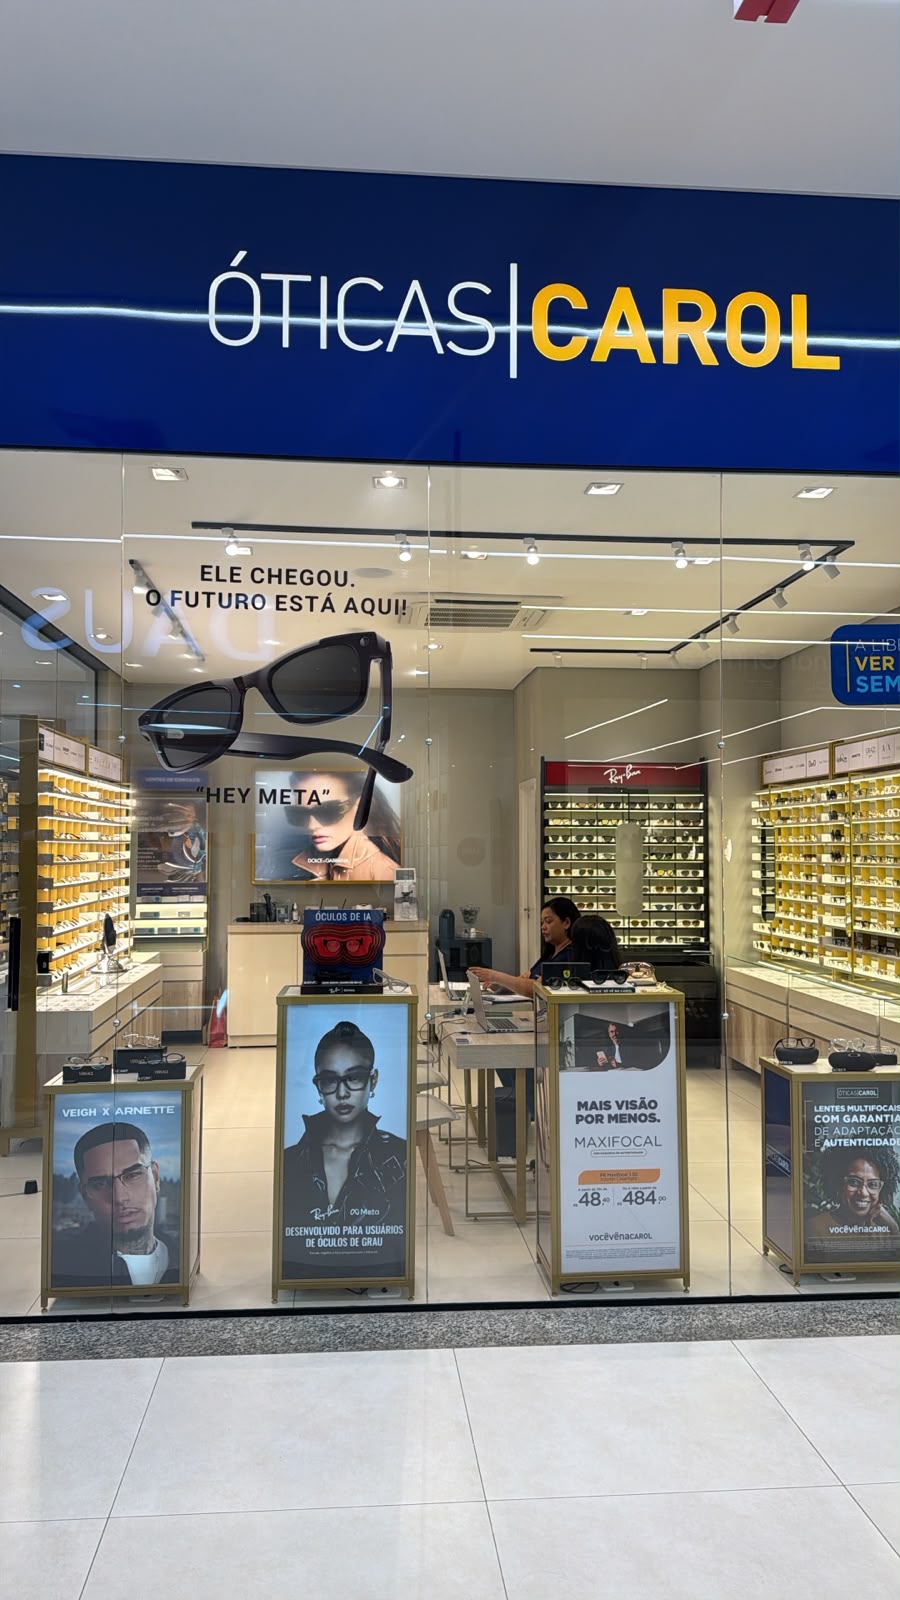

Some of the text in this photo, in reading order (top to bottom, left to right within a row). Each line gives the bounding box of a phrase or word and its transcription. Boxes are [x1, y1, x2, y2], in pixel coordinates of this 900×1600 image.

[207, 250, 841, 371] ÓTICAS CAROL
[200, 564, 356, 588] ELE CHEGOU.
[145, 588, 408, 617] O FUTURO ESTÁ AQUI!
[855, 638, 900, 652] A LIB
[854, 655, 895, 671] VER
[603, 763, 641, 784] Ray-Ban
[315, 911, 372, 921] ÓCULOS DE IA
[577, 1096, 658, 1112] MAIS VISÃO
[814, 1104, 900, 1113] LENTES MULTIFOCAIS
[62, 1105, 175, 1118] VEIGH X ARNETTE
[575, 1112, 661, 1125] POR MENOS.
[814, 1114, 900, 1123] COM GARANTIA
[814, 1126, 829, 1136] DE
[574, 1135, 662, 1149] MAXIFOCAL
[814, 1139, 820, 1147] E
[285, 1222, 404, 1237] DESENVOLVIDO PARA USUÁRIOS
[305, 1235, 383, 1248] DE ÓCULOS DE GRAU
